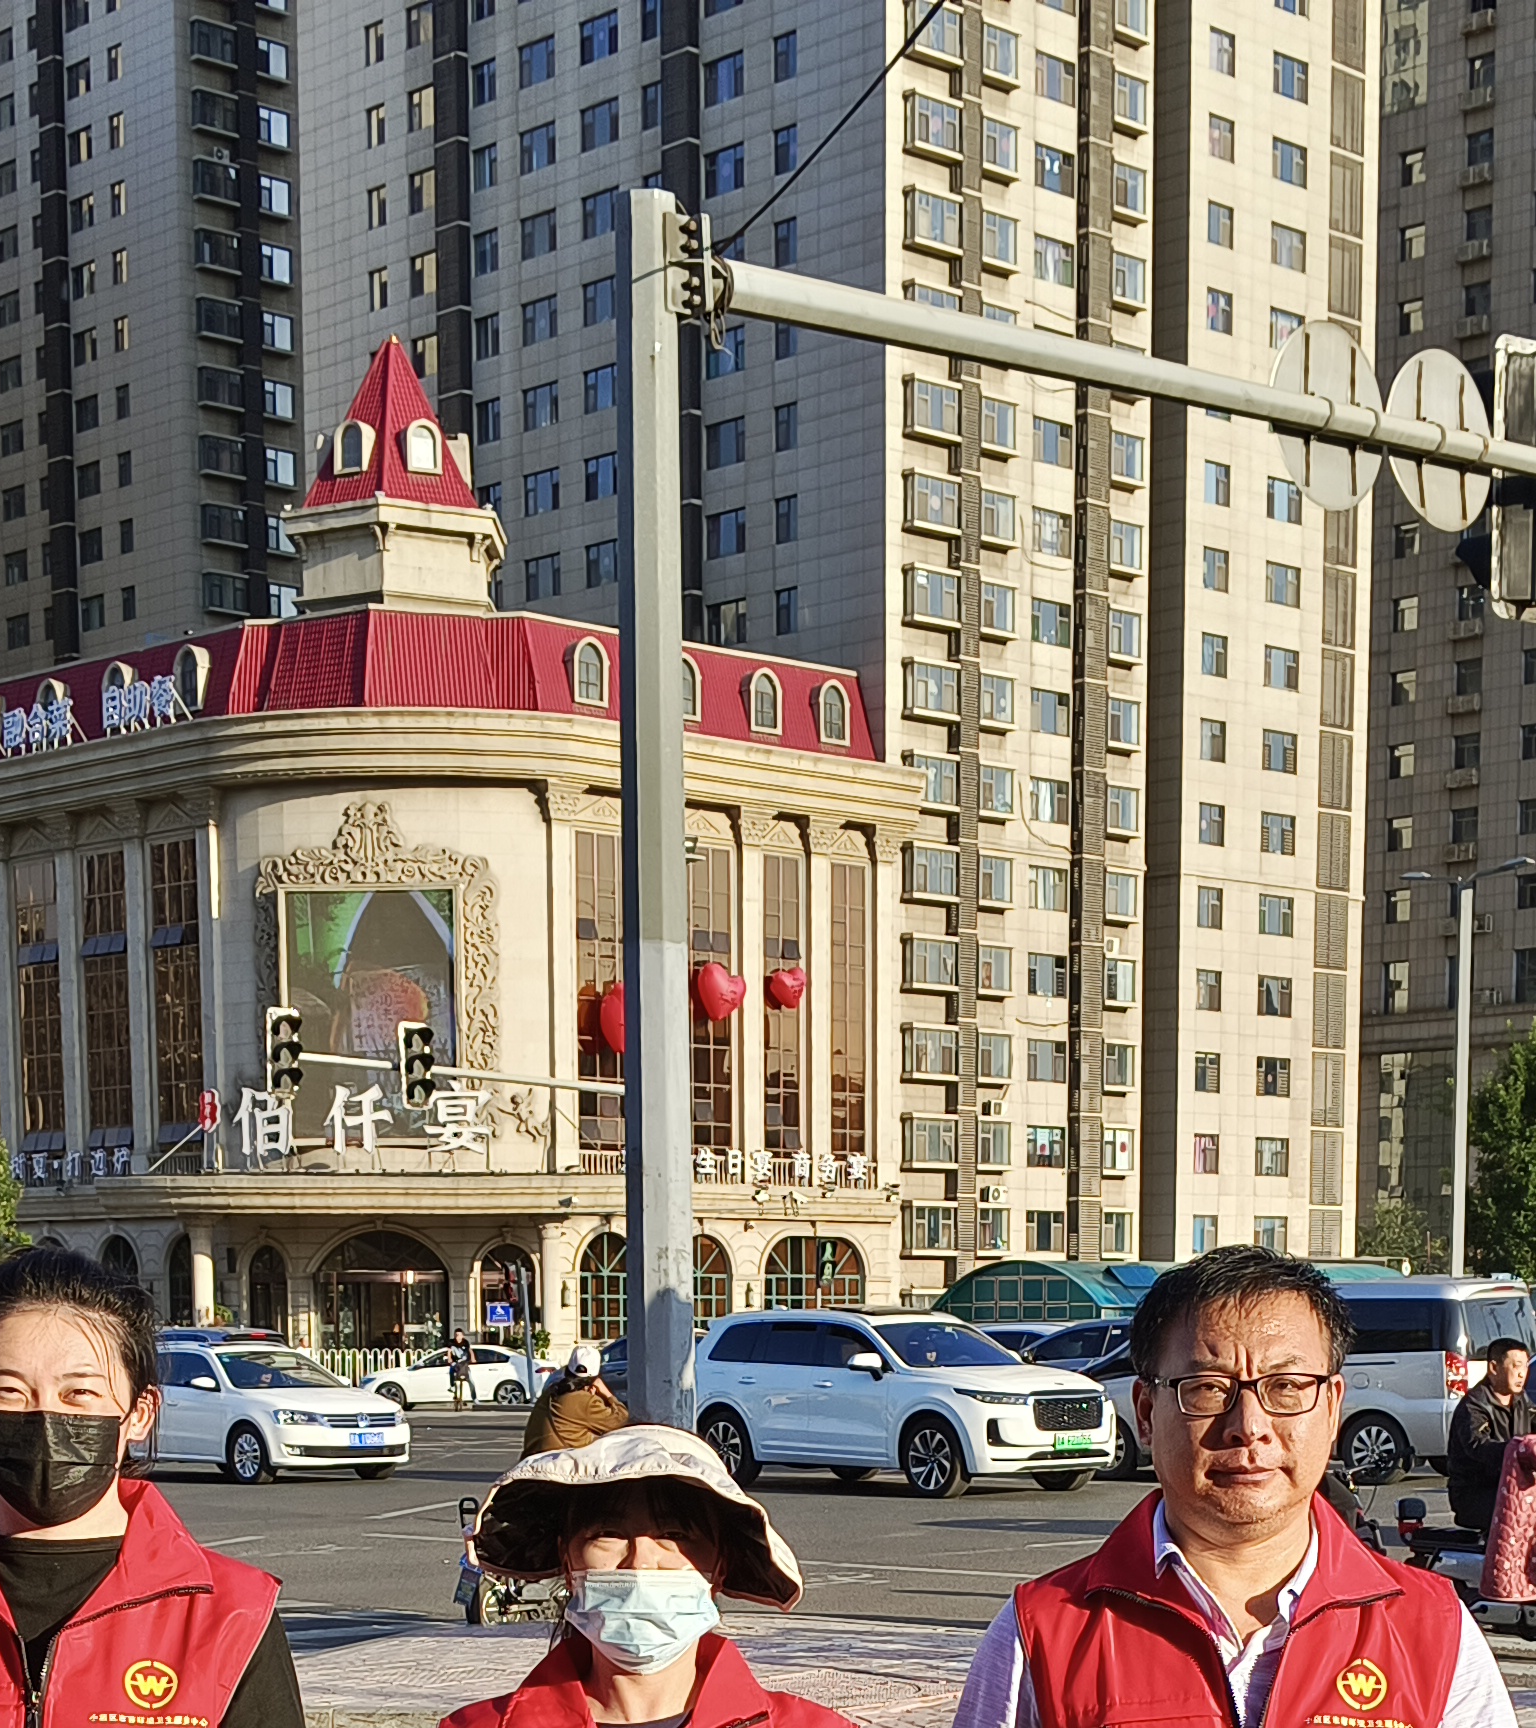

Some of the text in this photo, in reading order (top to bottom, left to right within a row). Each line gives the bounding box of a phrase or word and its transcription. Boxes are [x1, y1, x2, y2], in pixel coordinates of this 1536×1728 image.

[2, 697, 74, 749] 融合菜
[101, 675, 176, 730] 自助餐
[232, 1081, 493, 1156] 佰仟宴
[695, 1147, 773, 1177] 生日宴
